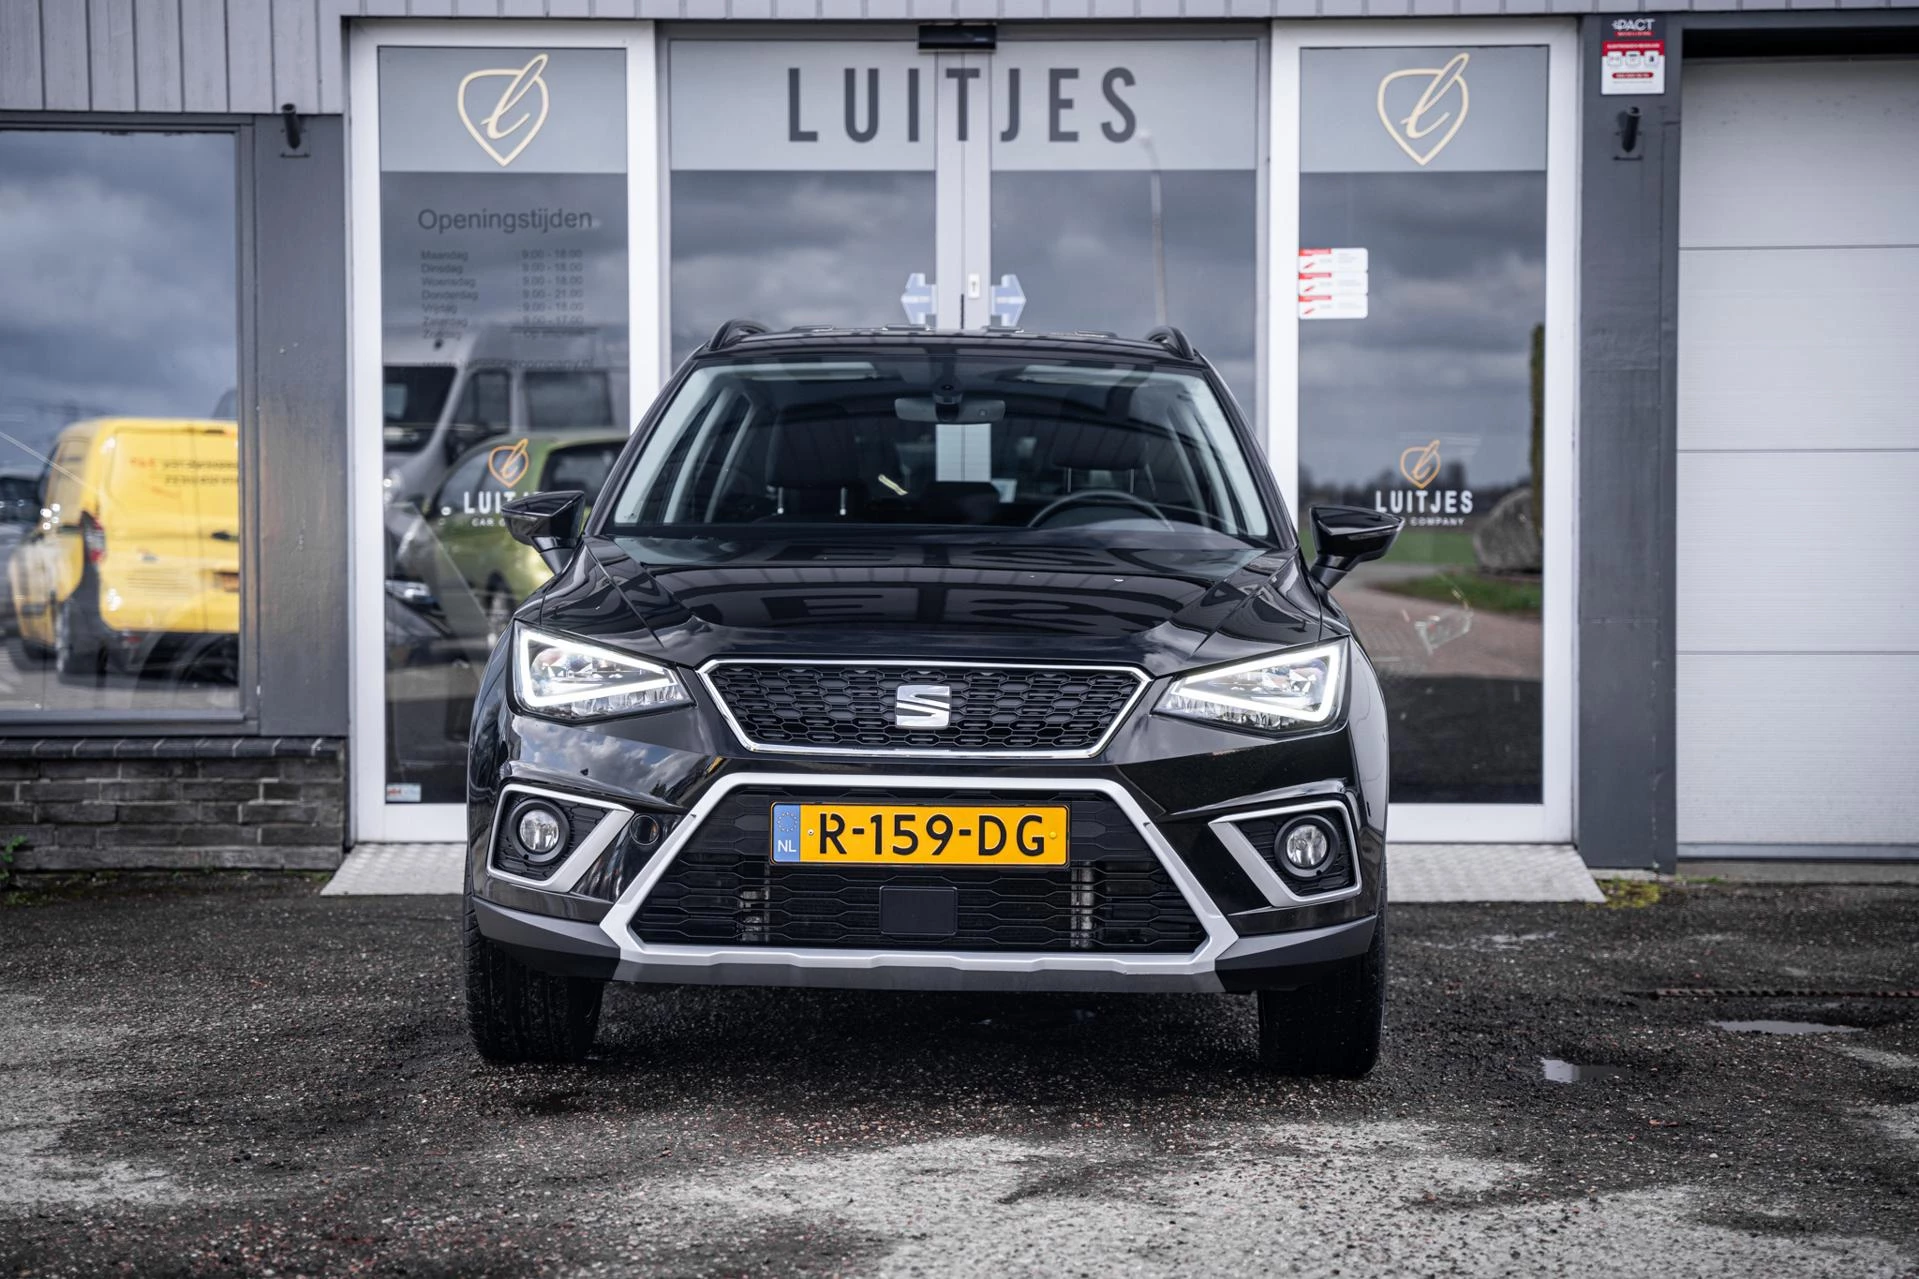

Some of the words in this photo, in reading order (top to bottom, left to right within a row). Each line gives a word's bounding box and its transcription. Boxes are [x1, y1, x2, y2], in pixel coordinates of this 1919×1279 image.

[788, 67, 1136, 143] LUITJES
[418, 208, 593, 234] Openingstijden
[1376, 490, 1472, 513] LUITJES
[1410, 517, 1465, 527] COMPANY
[777, 839, 797, 853] NL
[819, 813, 1045, 856] R-159-DG
